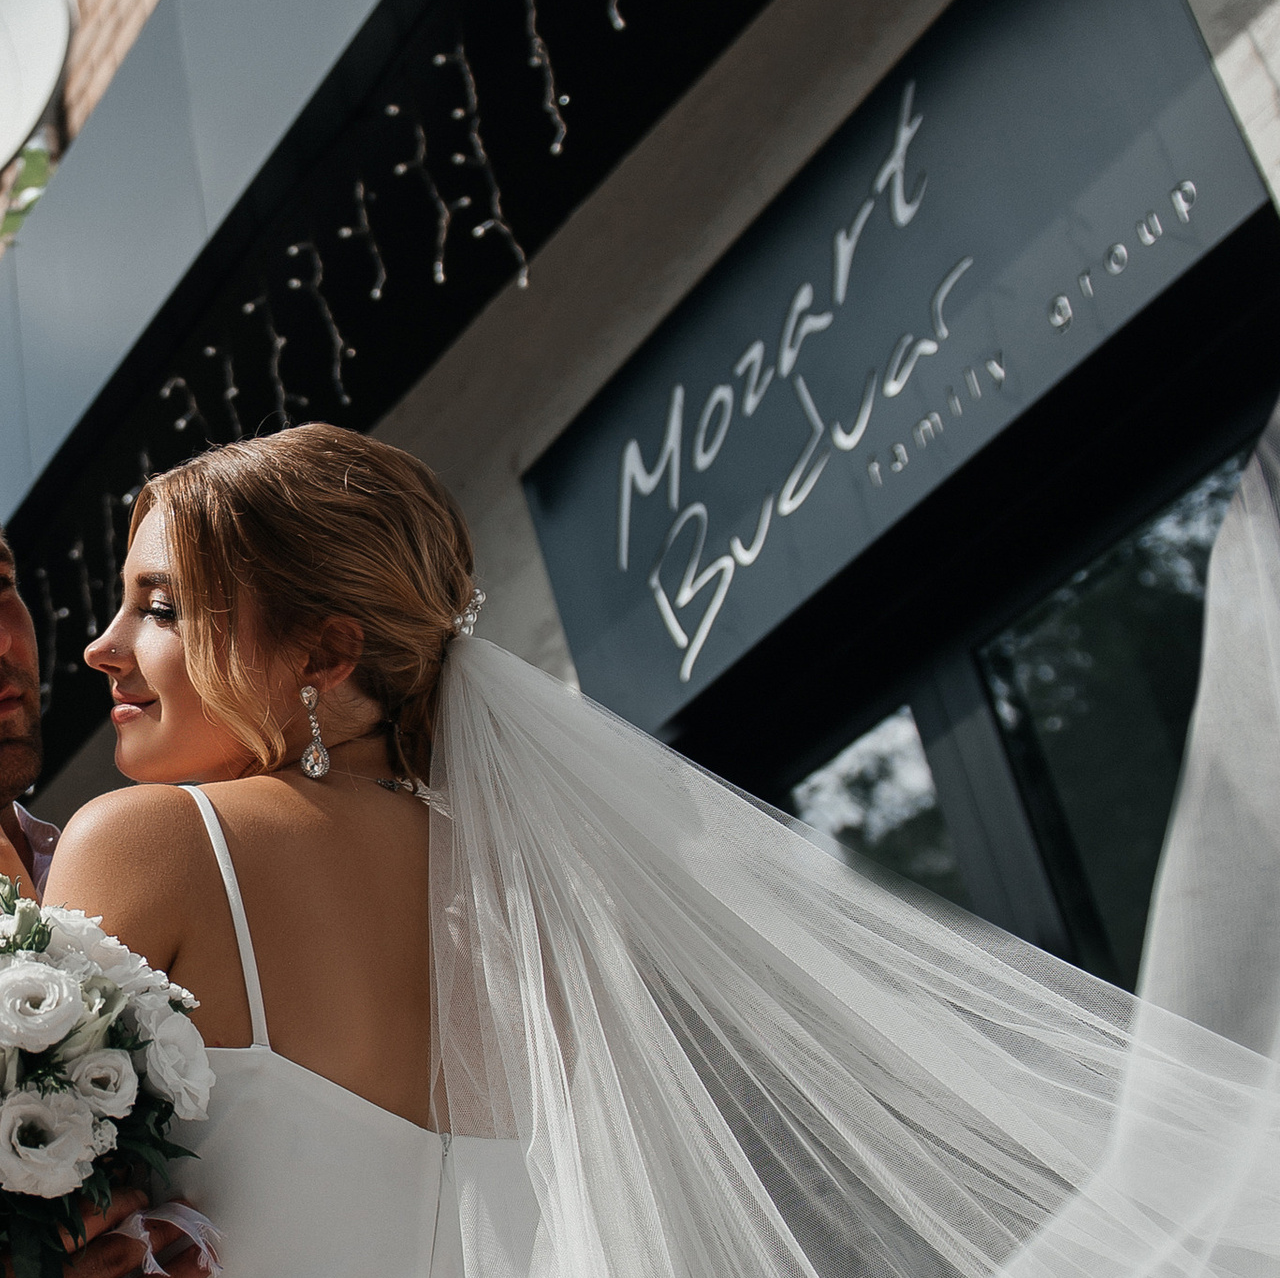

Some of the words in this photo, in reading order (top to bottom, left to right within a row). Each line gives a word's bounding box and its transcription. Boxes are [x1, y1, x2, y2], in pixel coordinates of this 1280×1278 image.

[620, 79, 929, 572] Mozart
[648, 255, 974, 683] Budvar
[867, 349, 1006, 488] family
[1047, 179, 1197, 335] group
